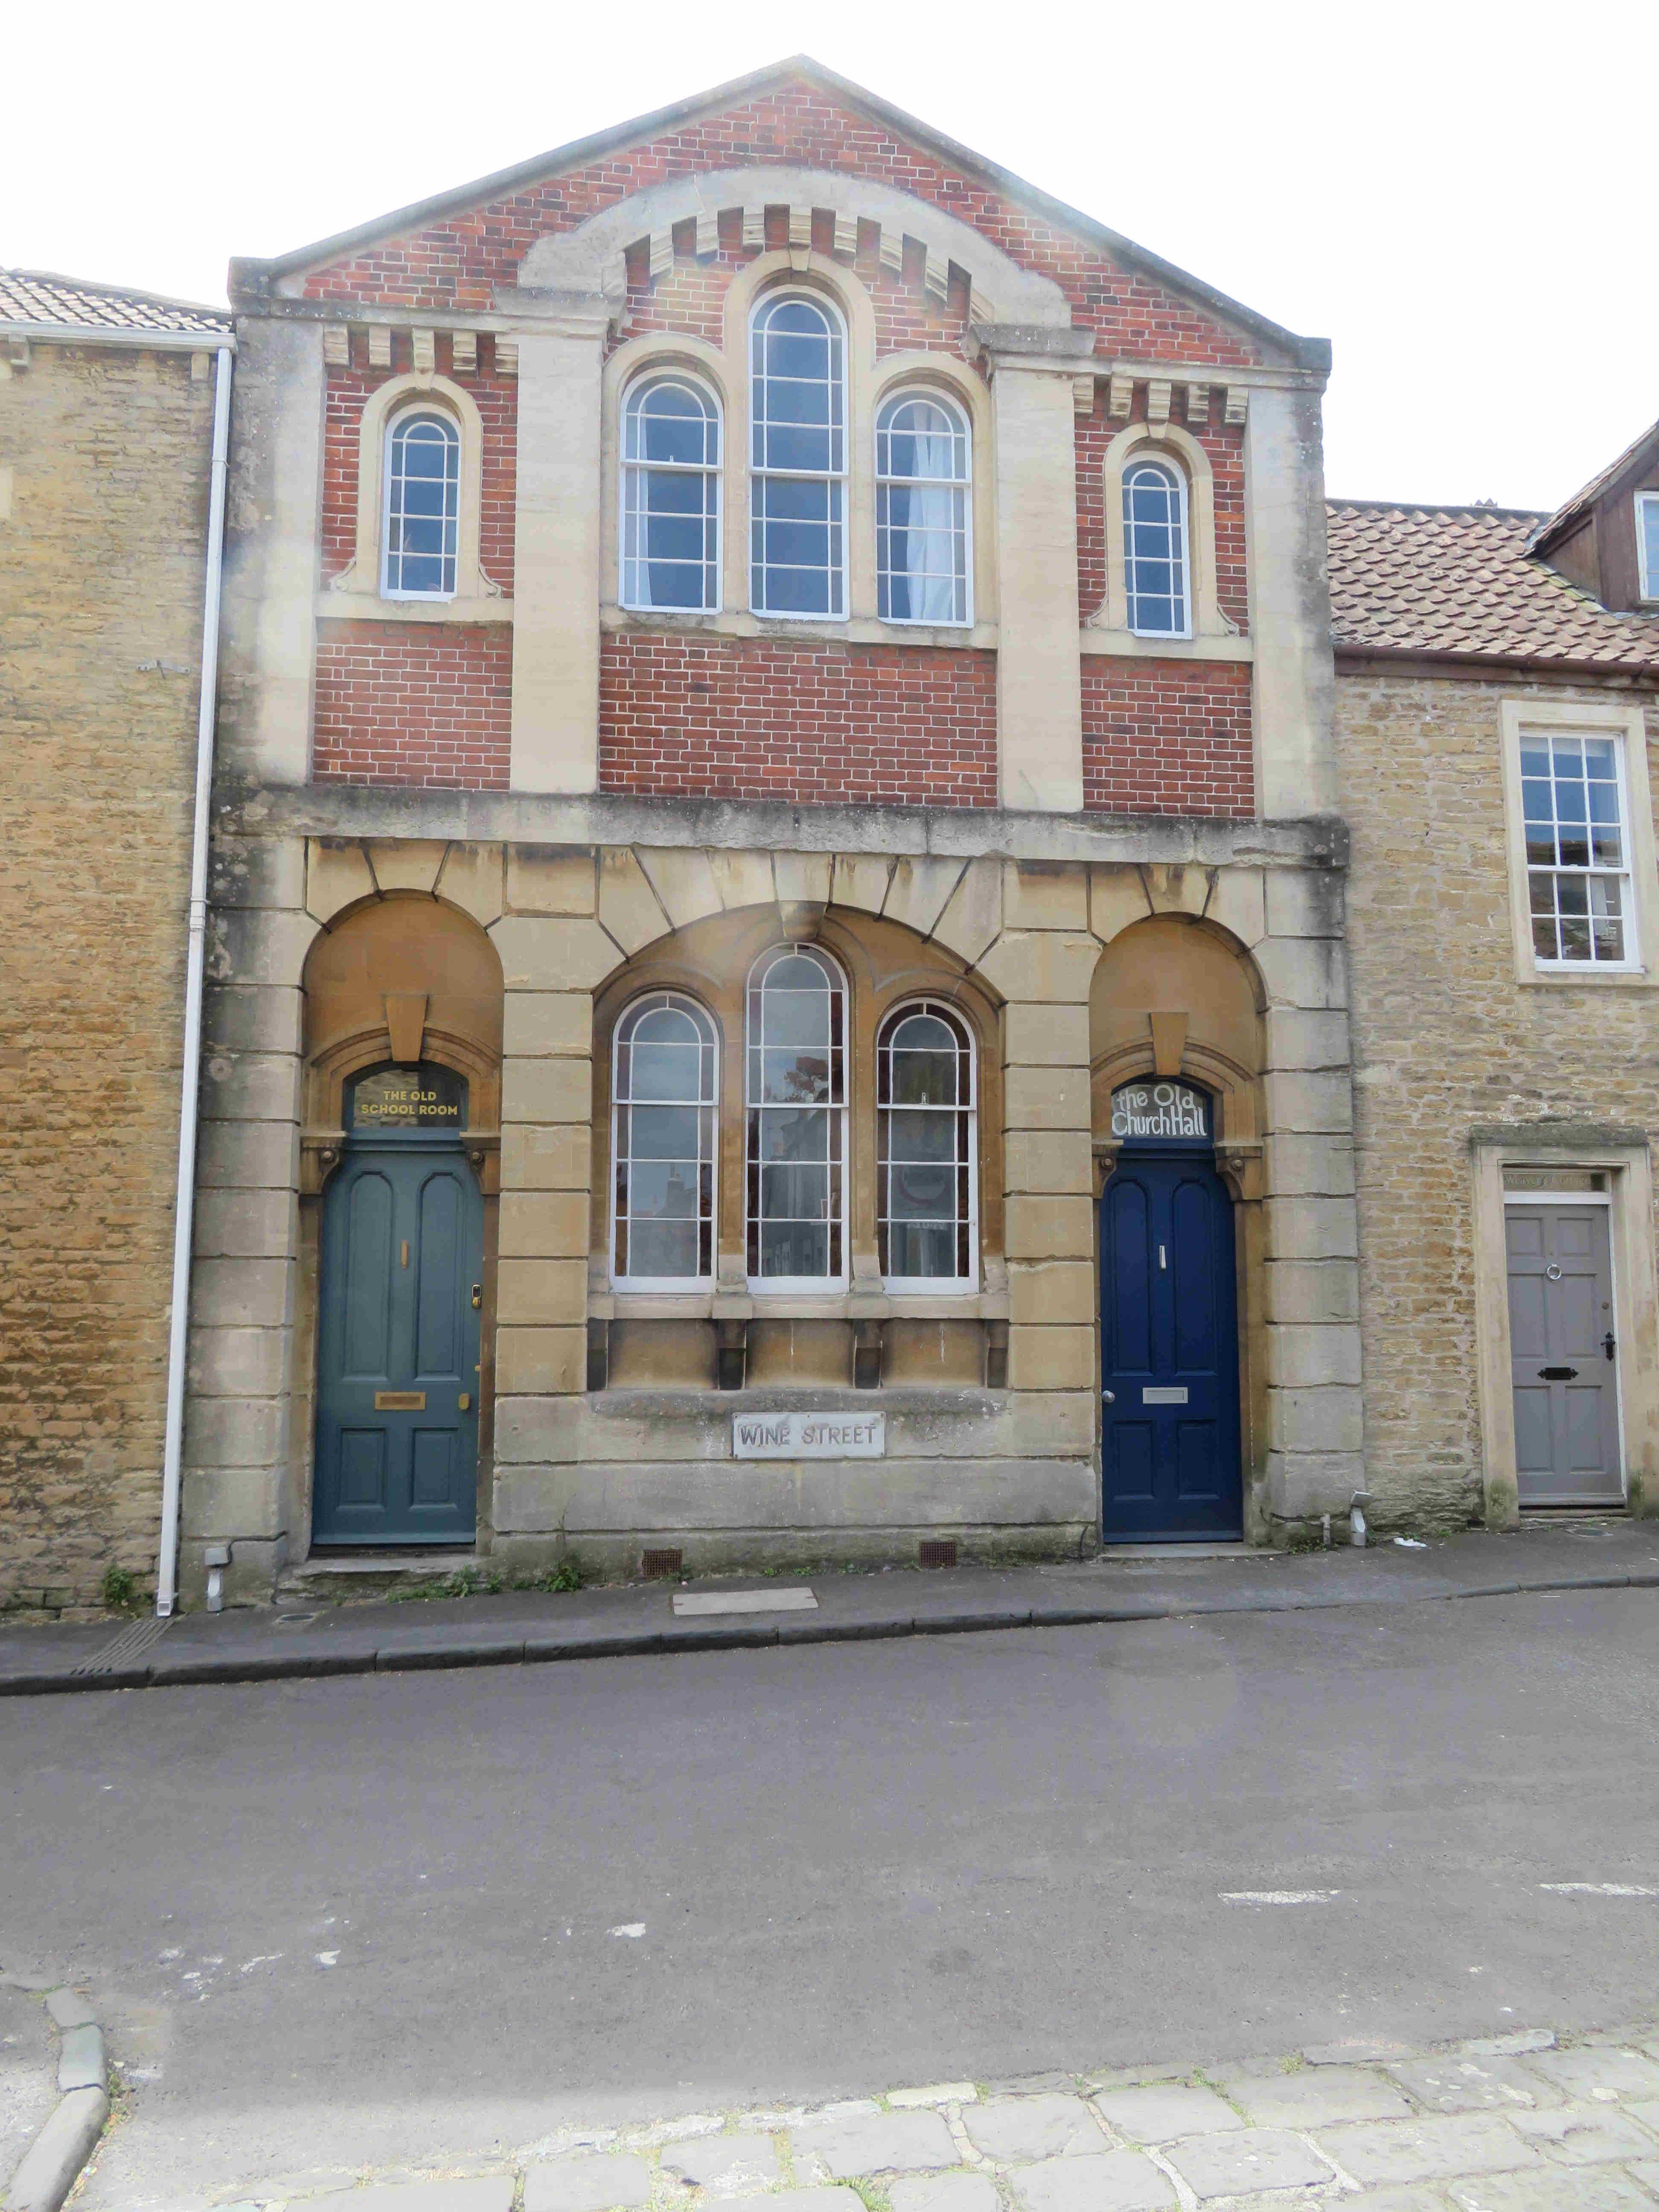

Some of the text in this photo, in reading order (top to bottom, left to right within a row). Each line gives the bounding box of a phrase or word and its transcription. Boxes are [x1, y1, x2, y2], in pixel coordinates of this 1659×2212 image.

[383, 1091, 437, 1101] THE OLD
[1116, 1084, 1196, 1111] the Old
[361, 1104, 458, 1115] SCHOOL ROOM
[1112, 1105, 1207, 1136] Church Hall
[739, 1424, 877, 1445] WINE STREET
